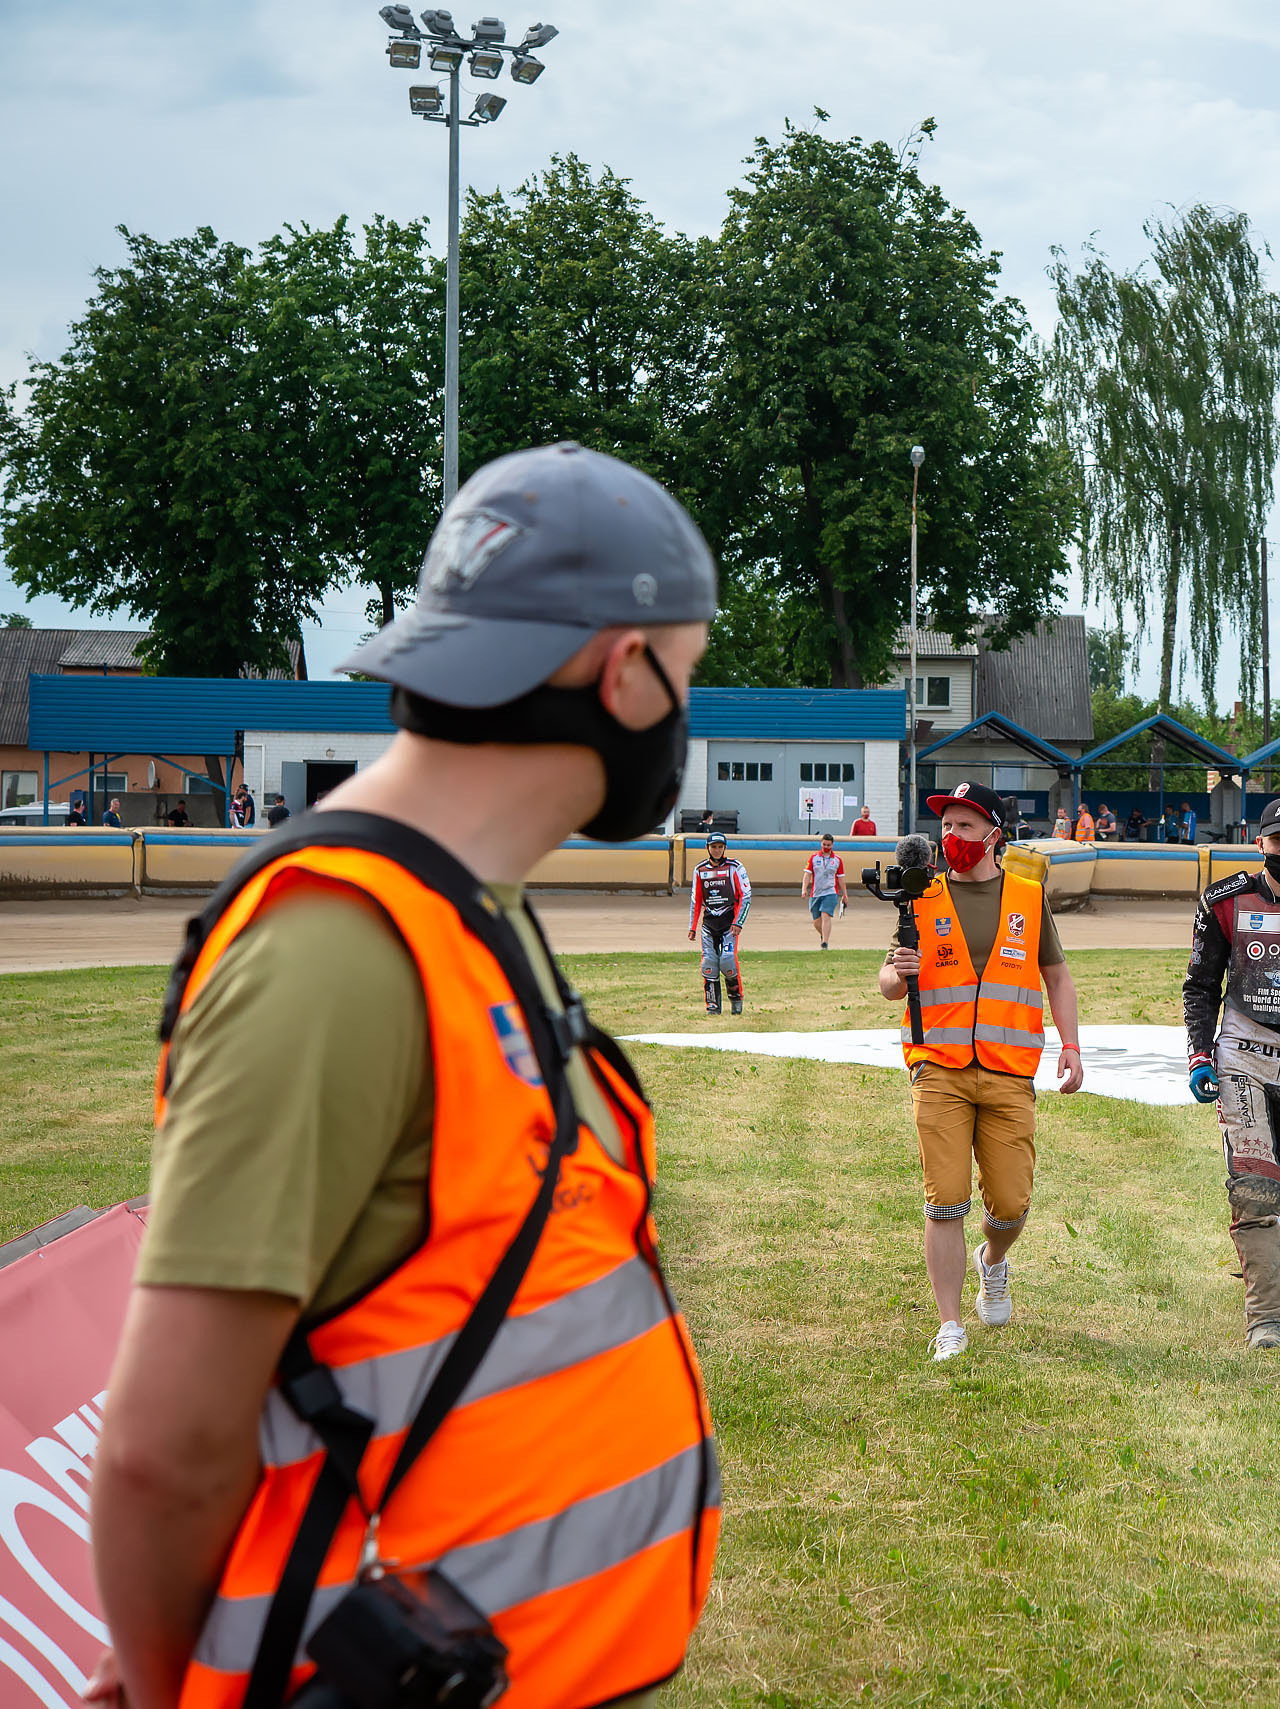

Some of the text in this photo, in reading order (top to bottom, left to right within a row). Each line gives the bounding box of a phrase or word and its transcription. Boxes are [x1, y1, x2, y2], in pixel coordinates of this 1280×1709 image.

[935, 959, 959, 968] CARGO
[1257, 988, 1270, 996] FIM
[1252, 995, 1272, 1004] World
[1236, 1146, 1273, 1160] LATVIA
